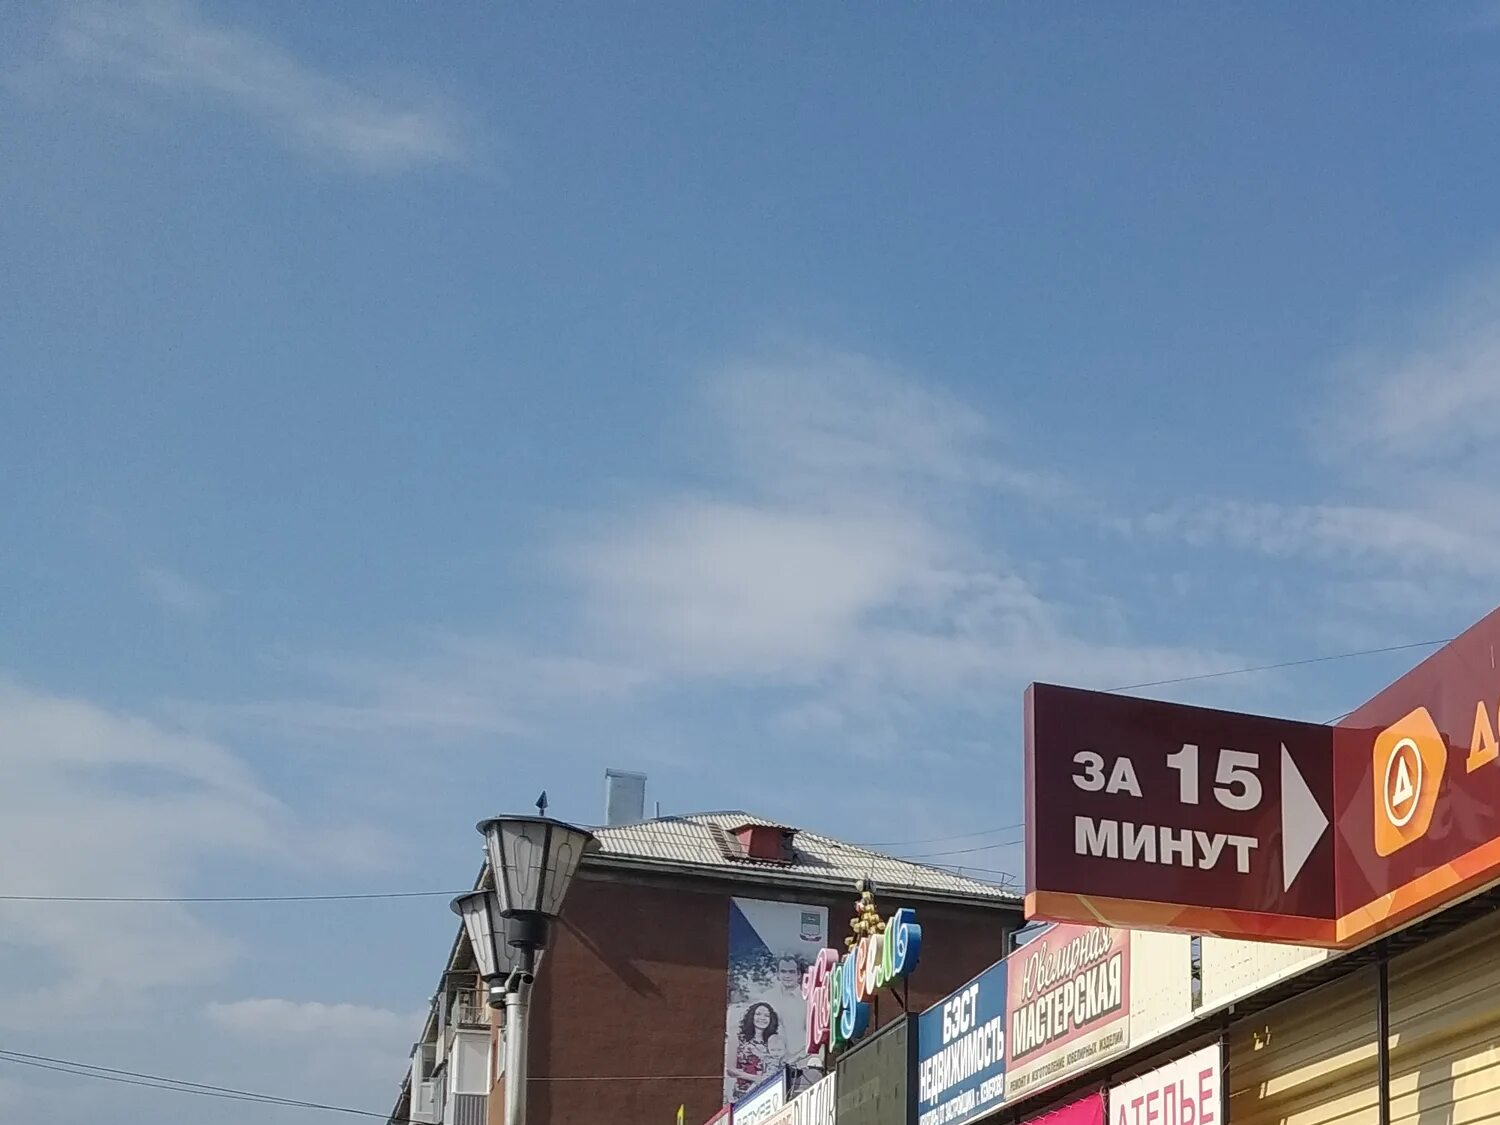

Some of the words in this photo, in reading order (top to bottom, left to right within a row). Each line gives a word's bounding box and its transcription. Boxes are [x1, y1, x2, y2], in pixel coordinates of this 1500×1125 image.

[1072, 751, 1143, 798] ЗА
[1166, 743, 1264, 812] 15
[1074, 816, 1259, 875] МИНУТ
[801, 908, 918, 1055] Карусель
[1022, 926, 1113, 1004] Ювелирная
[943, 984, 979, 1045] БЭСТ
[1012, 952, 1122, 1059] МАСТЕРСКАЯ
[920, 1016, 1004, 1104] НЕДВИЖИМОСТЬ
